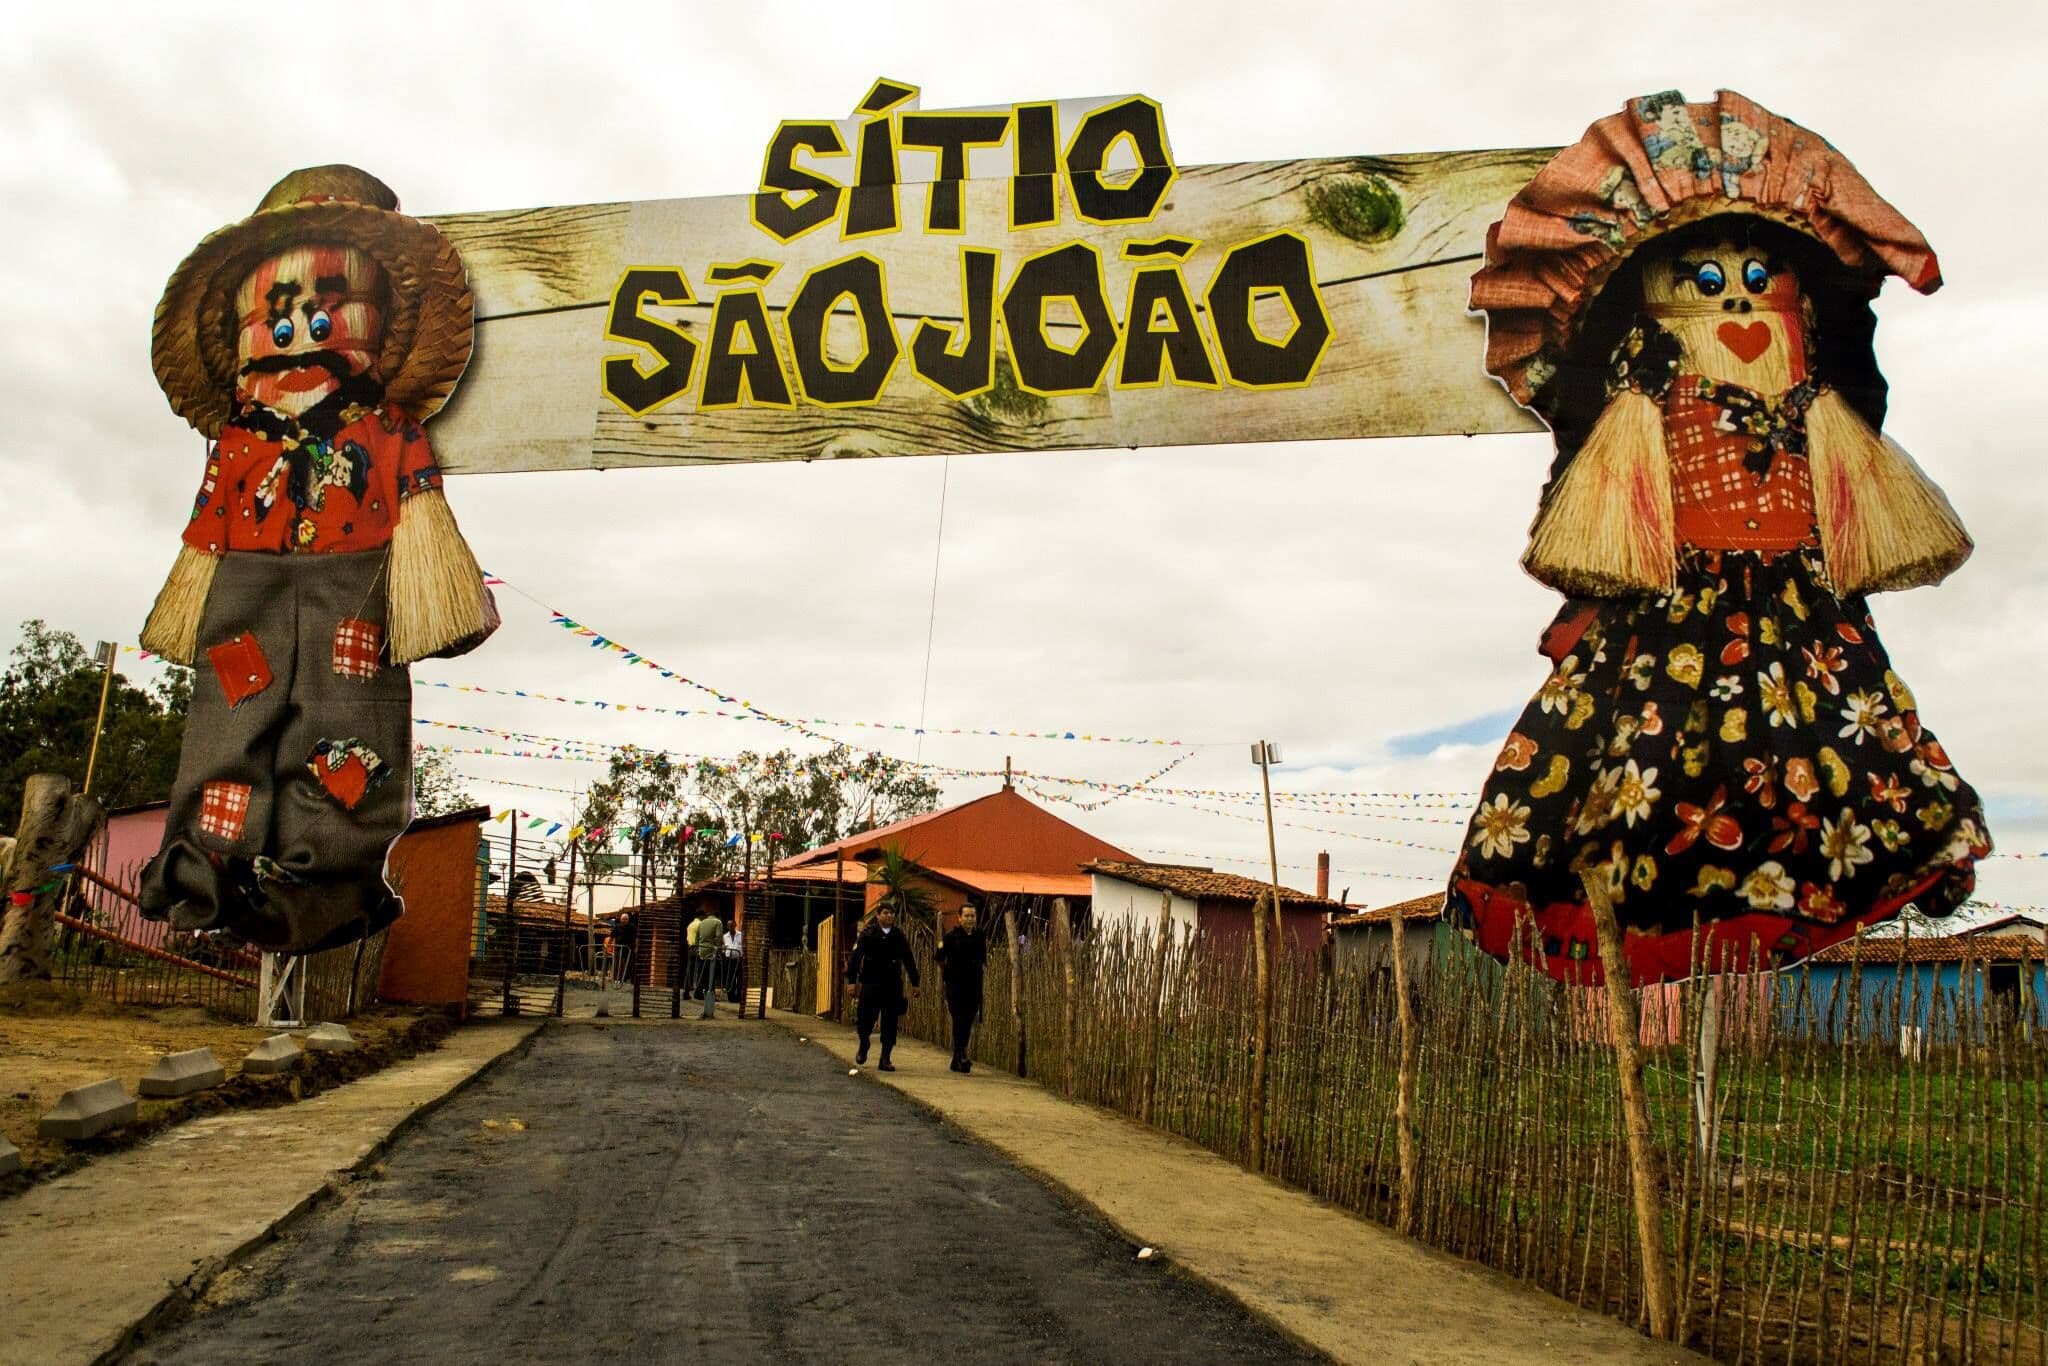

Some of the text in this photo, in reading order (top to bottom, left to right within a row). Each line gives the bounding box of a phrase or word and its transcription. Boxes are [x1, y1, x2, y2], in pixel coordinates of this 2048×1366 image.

[751, 77, 1179, 244] SÍTIO
[601, 229, 1332, 416] SÃO JOÃO
